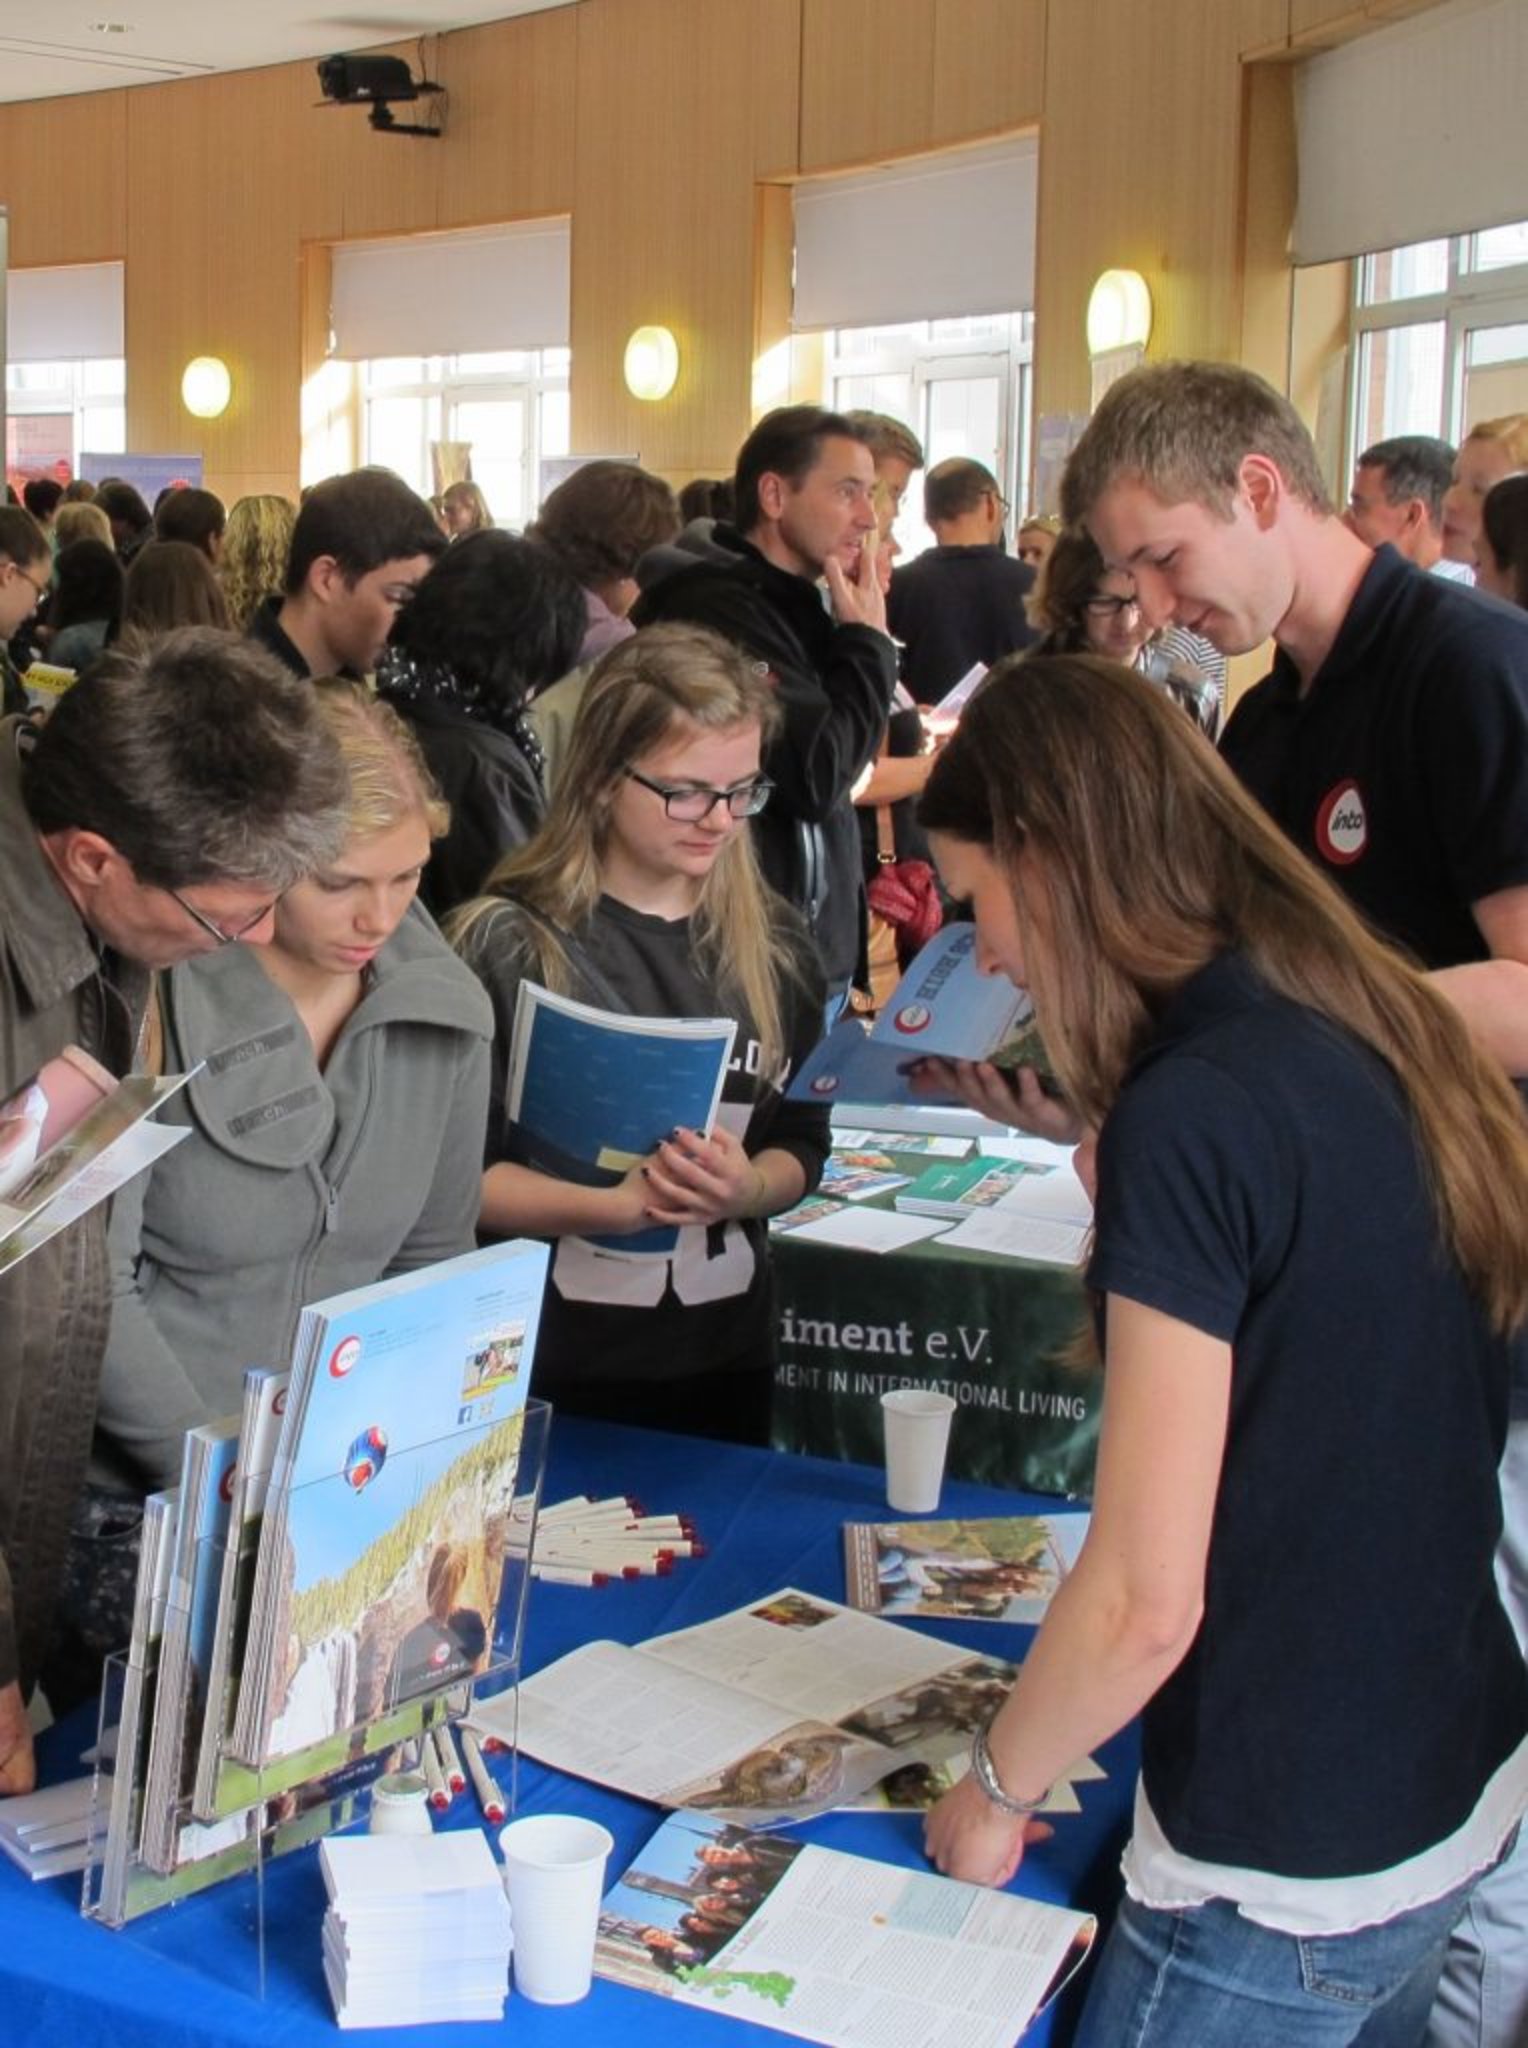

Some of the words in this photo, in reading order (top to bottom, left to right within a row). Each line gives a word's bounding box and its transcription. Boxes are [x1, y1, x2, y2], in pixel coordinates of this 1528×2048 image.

[780, 1308, 913, 1356] iment
[925, 1325, 993, 1364] e.V.
[827, 1369, 848, 1393] IN
[1019, 1389, 1086, 1421] LIVING
